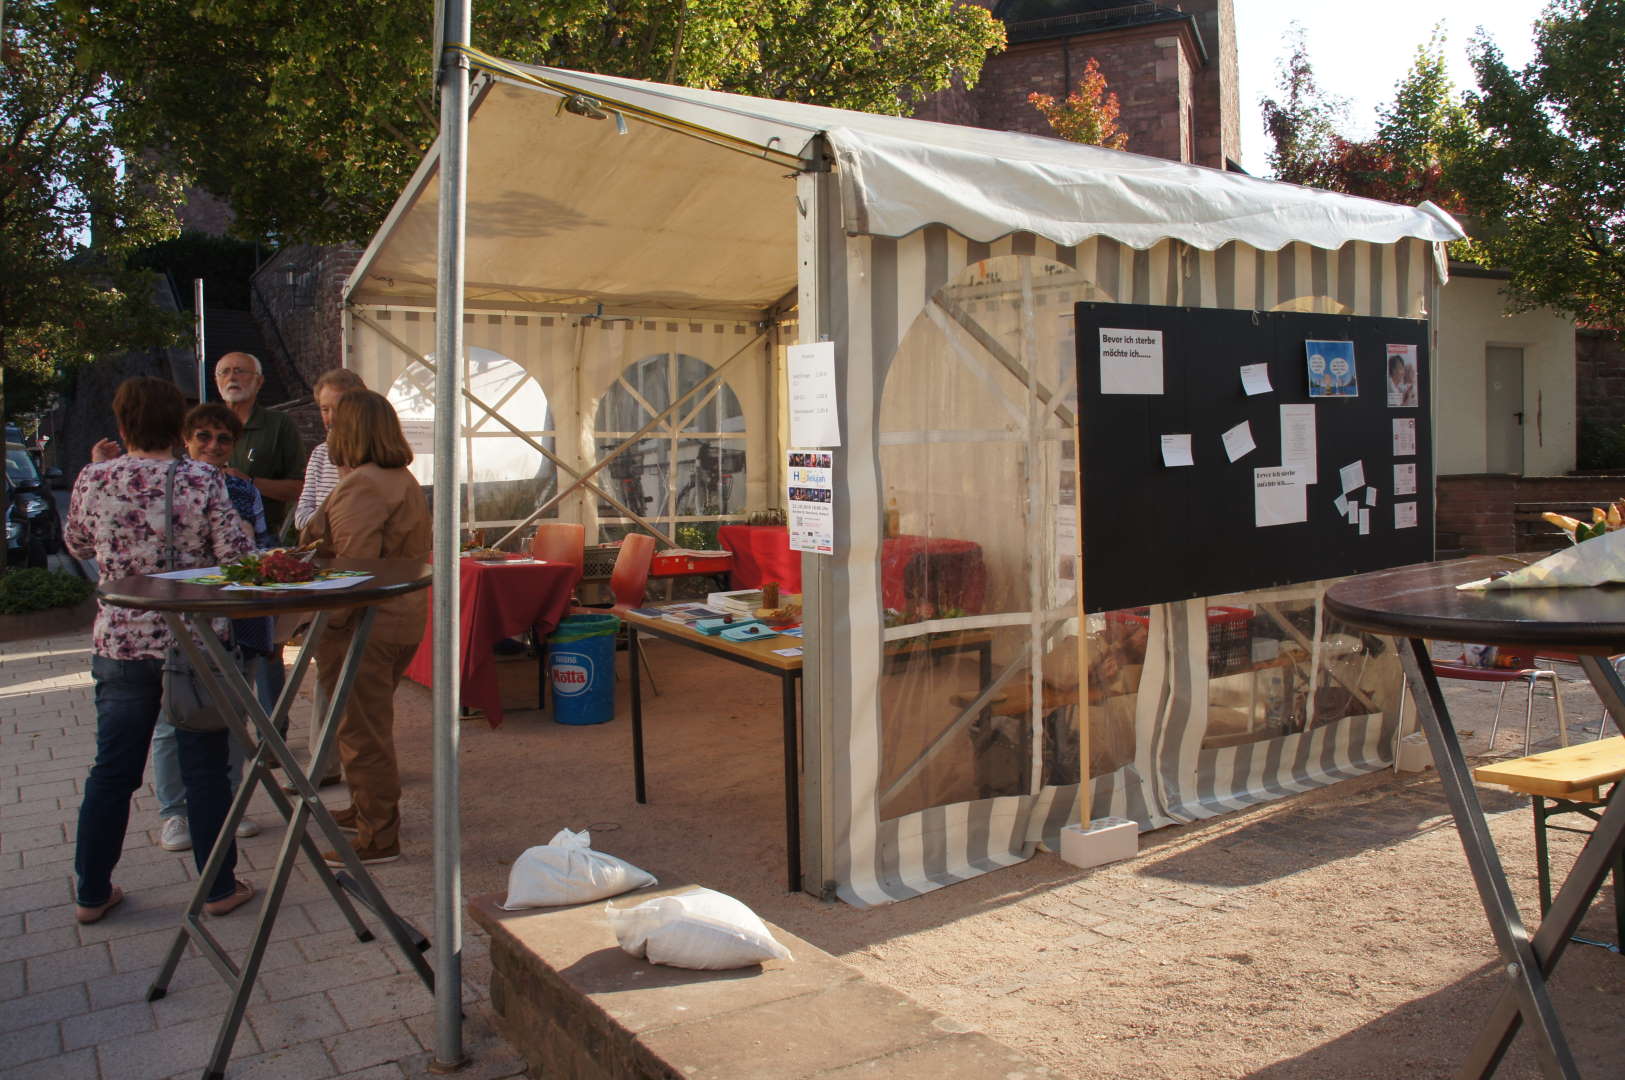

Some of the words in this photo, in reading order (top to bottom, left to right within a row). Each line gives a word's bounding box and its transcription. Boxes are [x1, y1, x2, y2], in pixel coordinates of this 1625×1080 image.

[1102, 334, 1122, 344] Bevor
[1124, 336, 1134, 344] ich
[1135, 336, 1155, 345] sterbe
[1103, 348, 1128, 358] möchte
[551, 668, 586, 684] Motta
